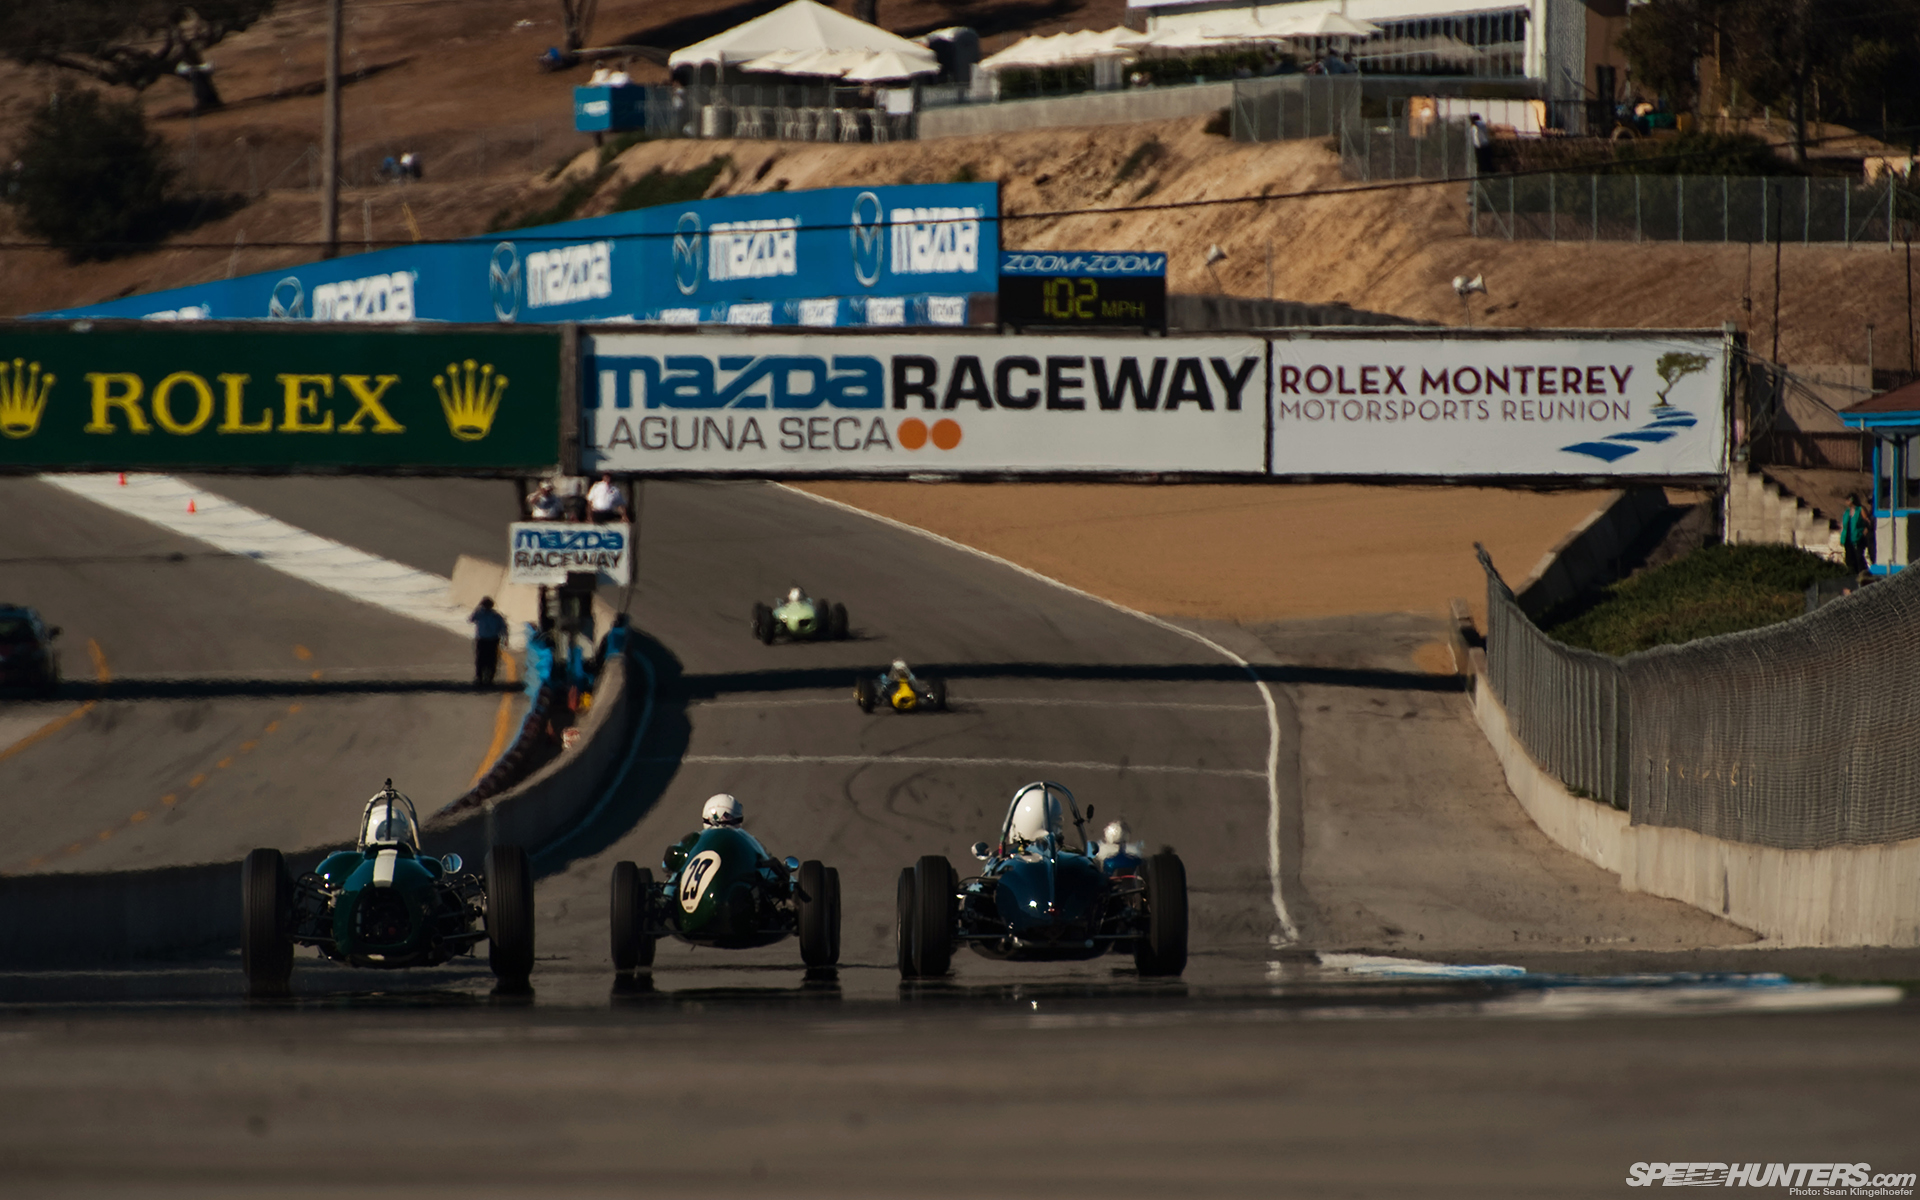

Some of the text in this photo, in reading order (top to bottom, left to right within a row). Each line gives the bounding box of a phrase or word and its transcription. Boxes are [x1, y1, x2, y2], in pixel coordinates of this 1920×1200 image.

[1002, 254, 1167, 274] ZOOM-ZOOM
[1043, 277, 1146, 319] 102 MPH
[583, 355, 1262, 410] mazda RACEWAY
[1279, 365, 1634, 395] ROLEX MONTEREY
[84, 371, 406, 436] ROLEX
[1279, 400, 1632, 422] MOTORSPORTS REUNION
[584, 416, 893, 452] LAGUNA SECA
[515, 551, 622, 568] RACEWAY
[682, 858, 713, 901] 29
